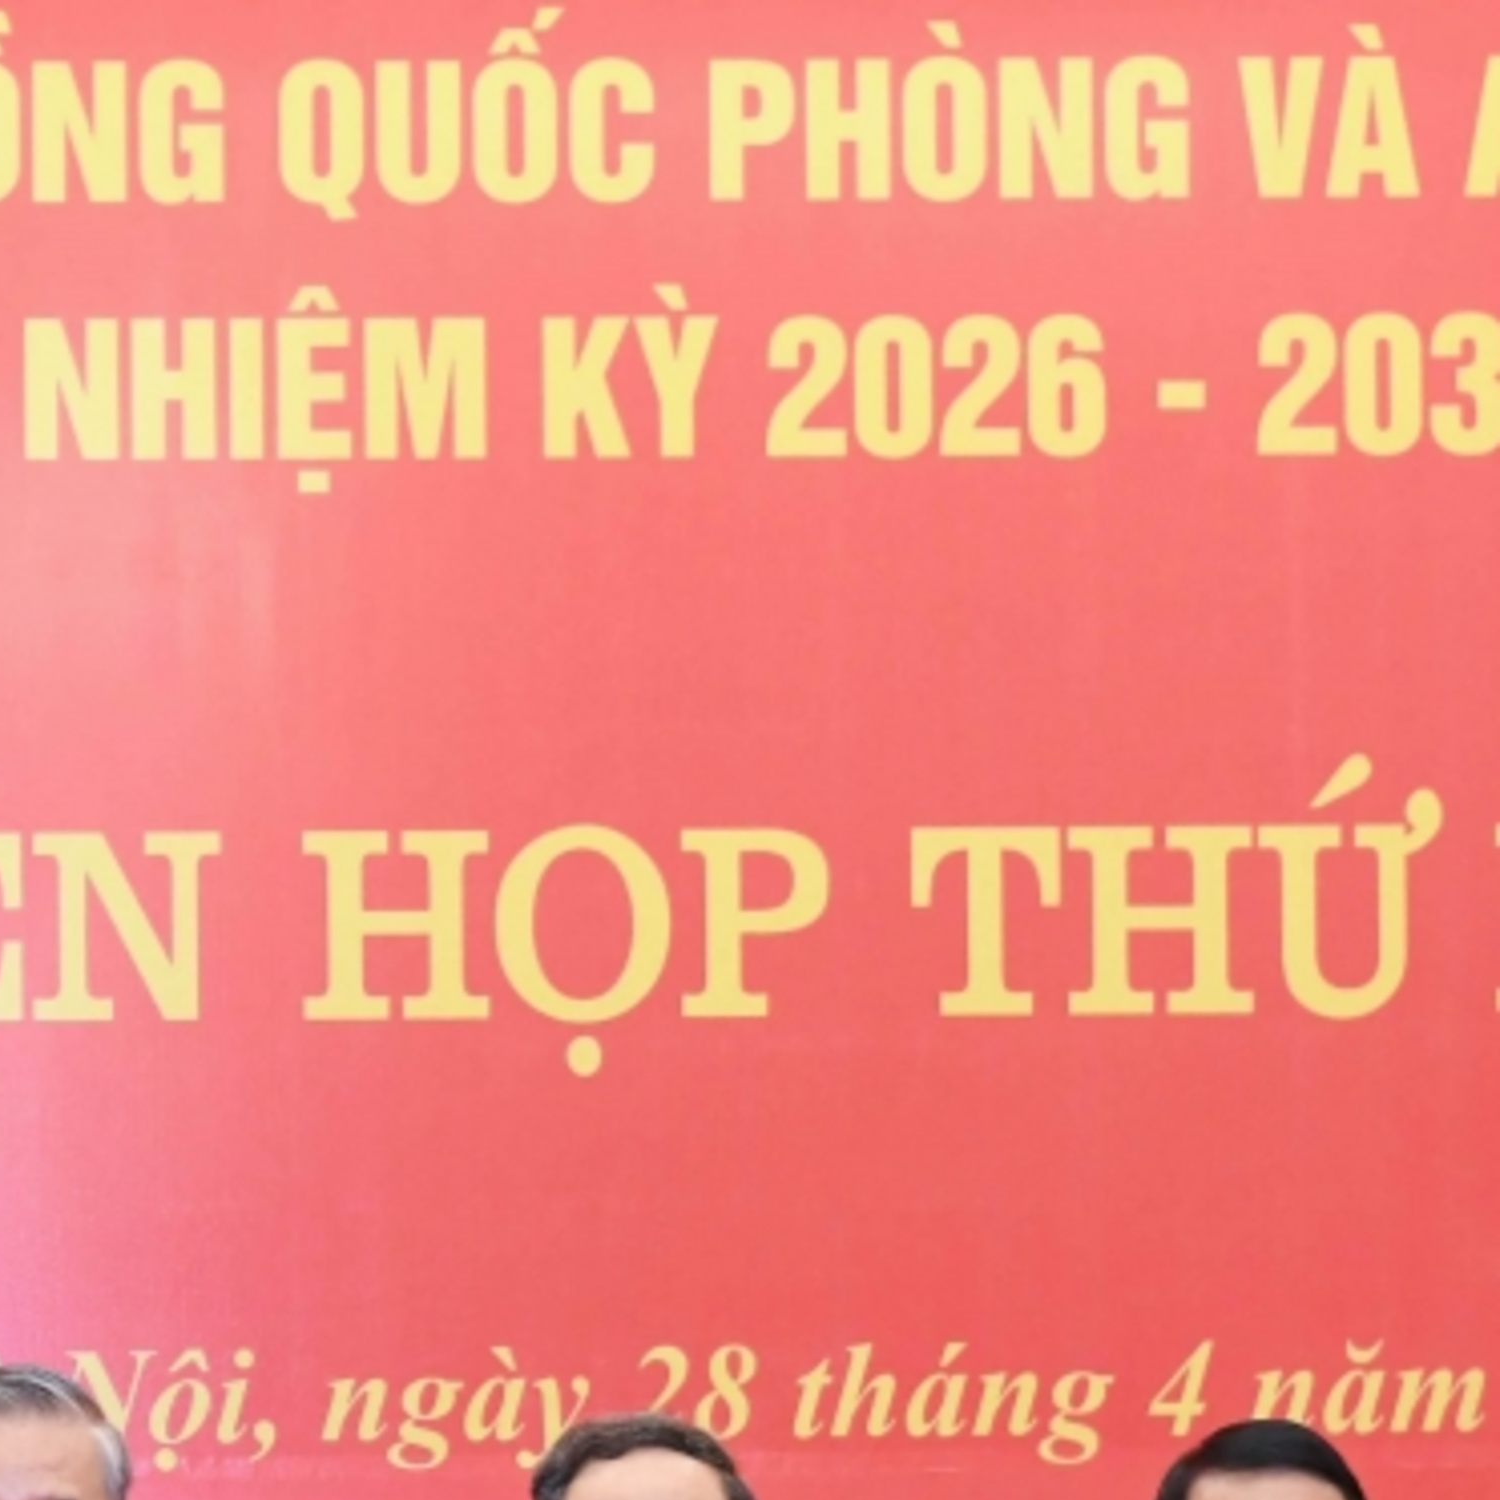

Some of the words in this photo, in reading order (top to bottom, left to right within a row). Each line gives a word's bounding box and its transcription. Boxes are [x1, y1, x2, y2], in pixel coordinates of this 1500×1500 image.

[277, 6, 657, 222] QUỐC
[707, 19, 1192, 204] PHÒNG
[1237, 23, 1421, 200] VÀ
[21, 284, 488, 494] NHIỆM
[540, 282, 719, 460] KỲ
[765, 312, 1107, 460] 2026
[1156, 379, 1207, 410] -
[301, 823, 830, 1077] HỌP
[910, 753, 1443, 1020] THỨ
[321, 1345, 591, 1470] ngày
[792, 1341, 1115, 1466] tháng
[1148, 1338, 1215, 1437] 4
[1250, 1338, 1486, 1436] năm
